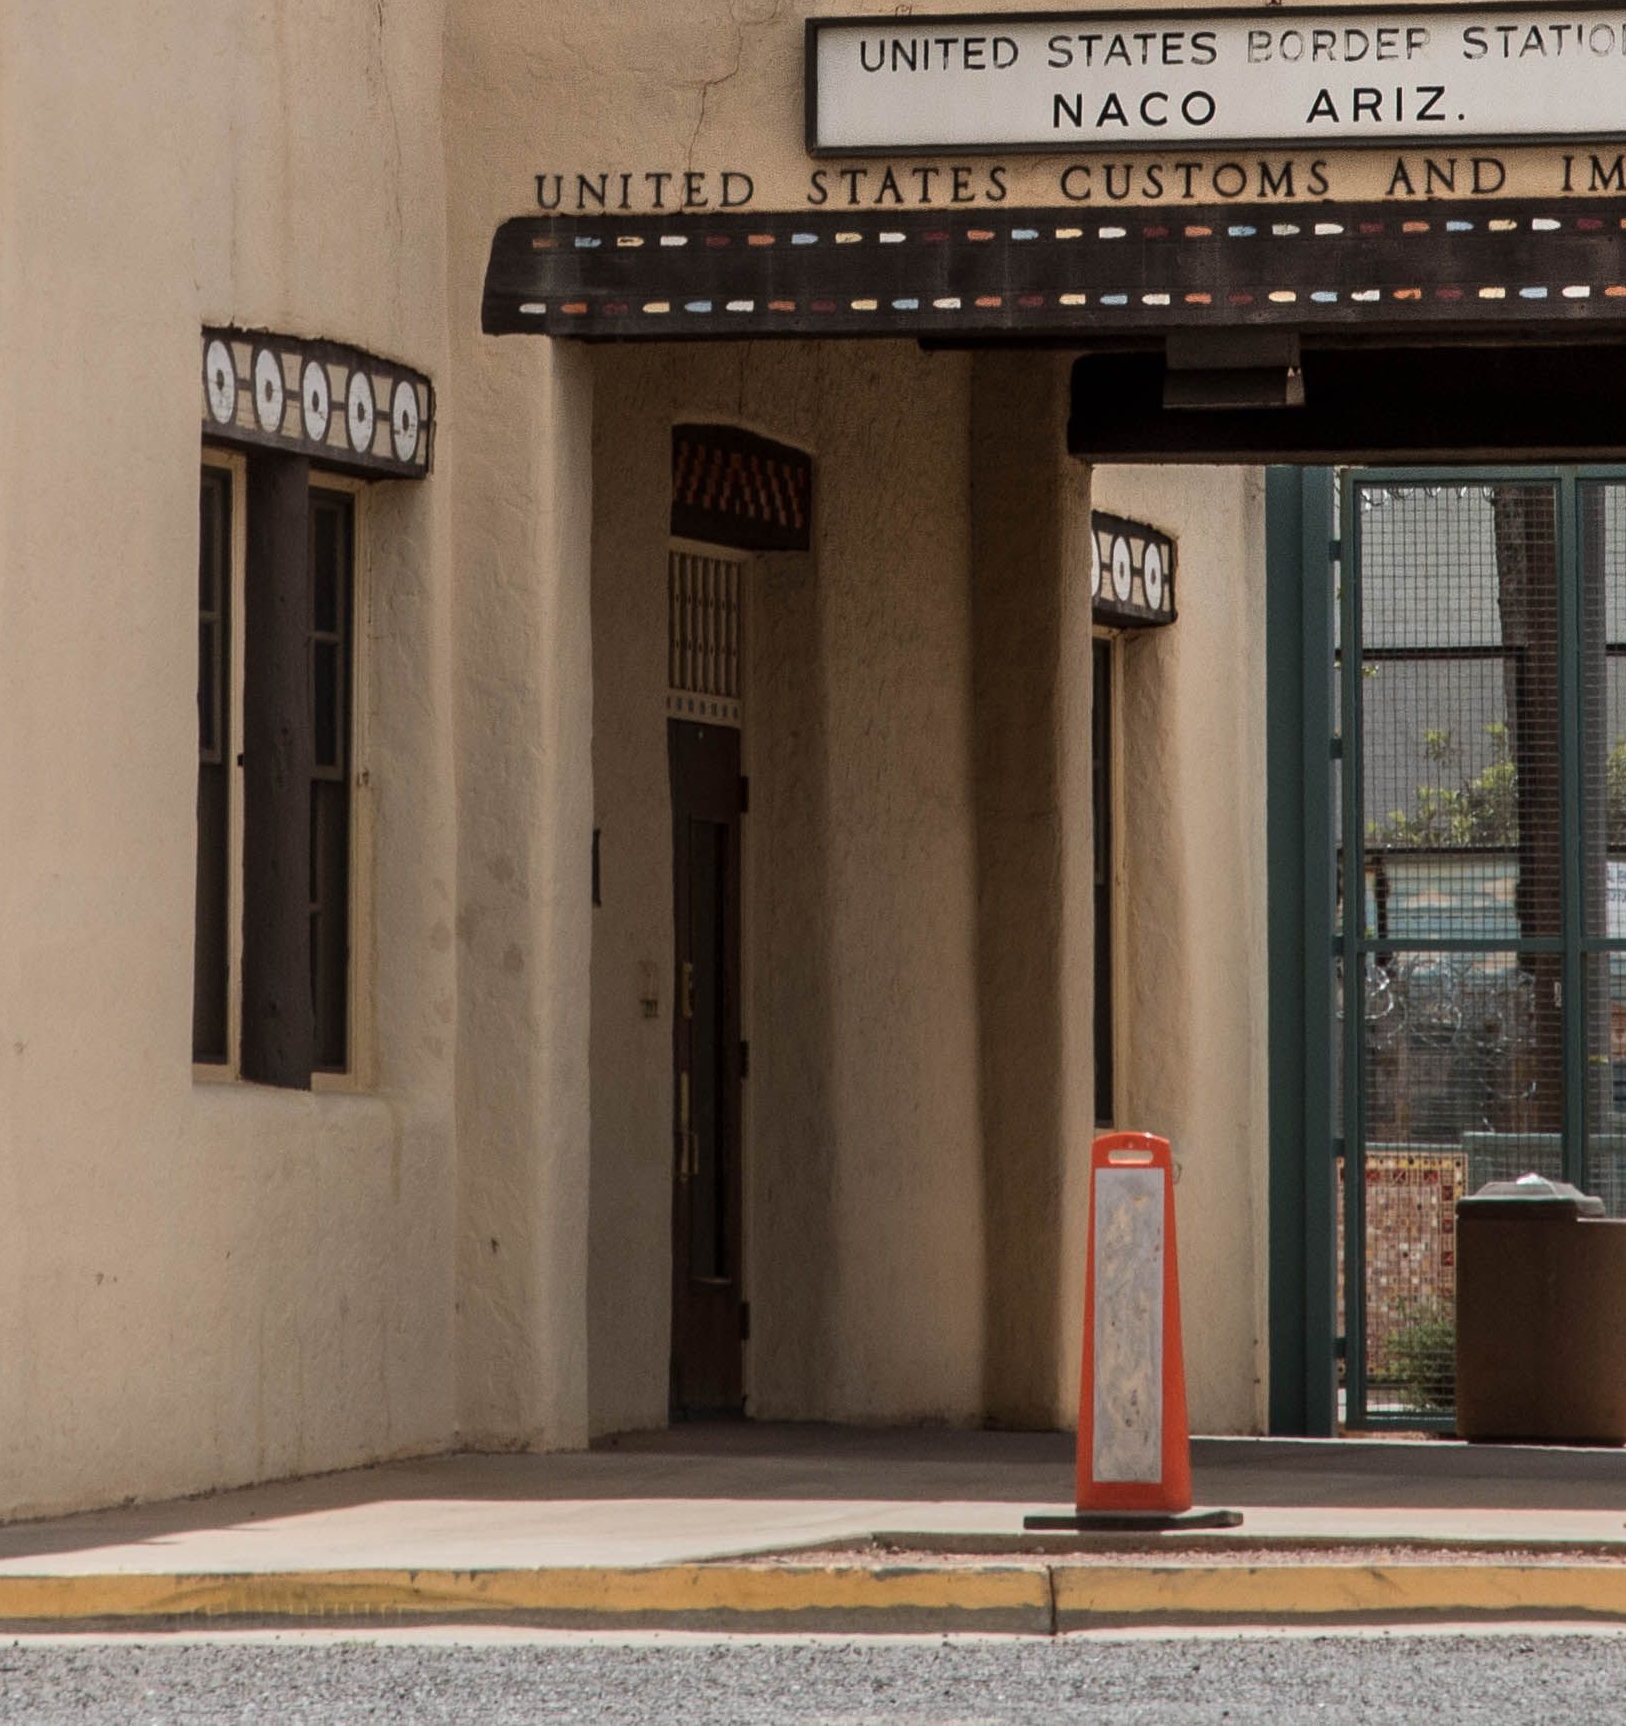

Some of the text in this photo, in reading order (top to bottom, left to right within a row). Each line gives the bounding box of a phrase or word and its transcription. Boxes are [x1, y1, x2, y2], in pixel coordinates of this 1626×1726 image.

[859, 36, 1020, 72] UNITED
[1046, 31, 1218, 69] STATES
[1052, 85, 1468, 129] NACO ARIZ.
[534, 173, 757, 210] UNITED
[806, 167, 1008, 206] STATES
[1059, 159, 1331, 202] CUSTOMS
[1384, 154, 1507, 196] AND
